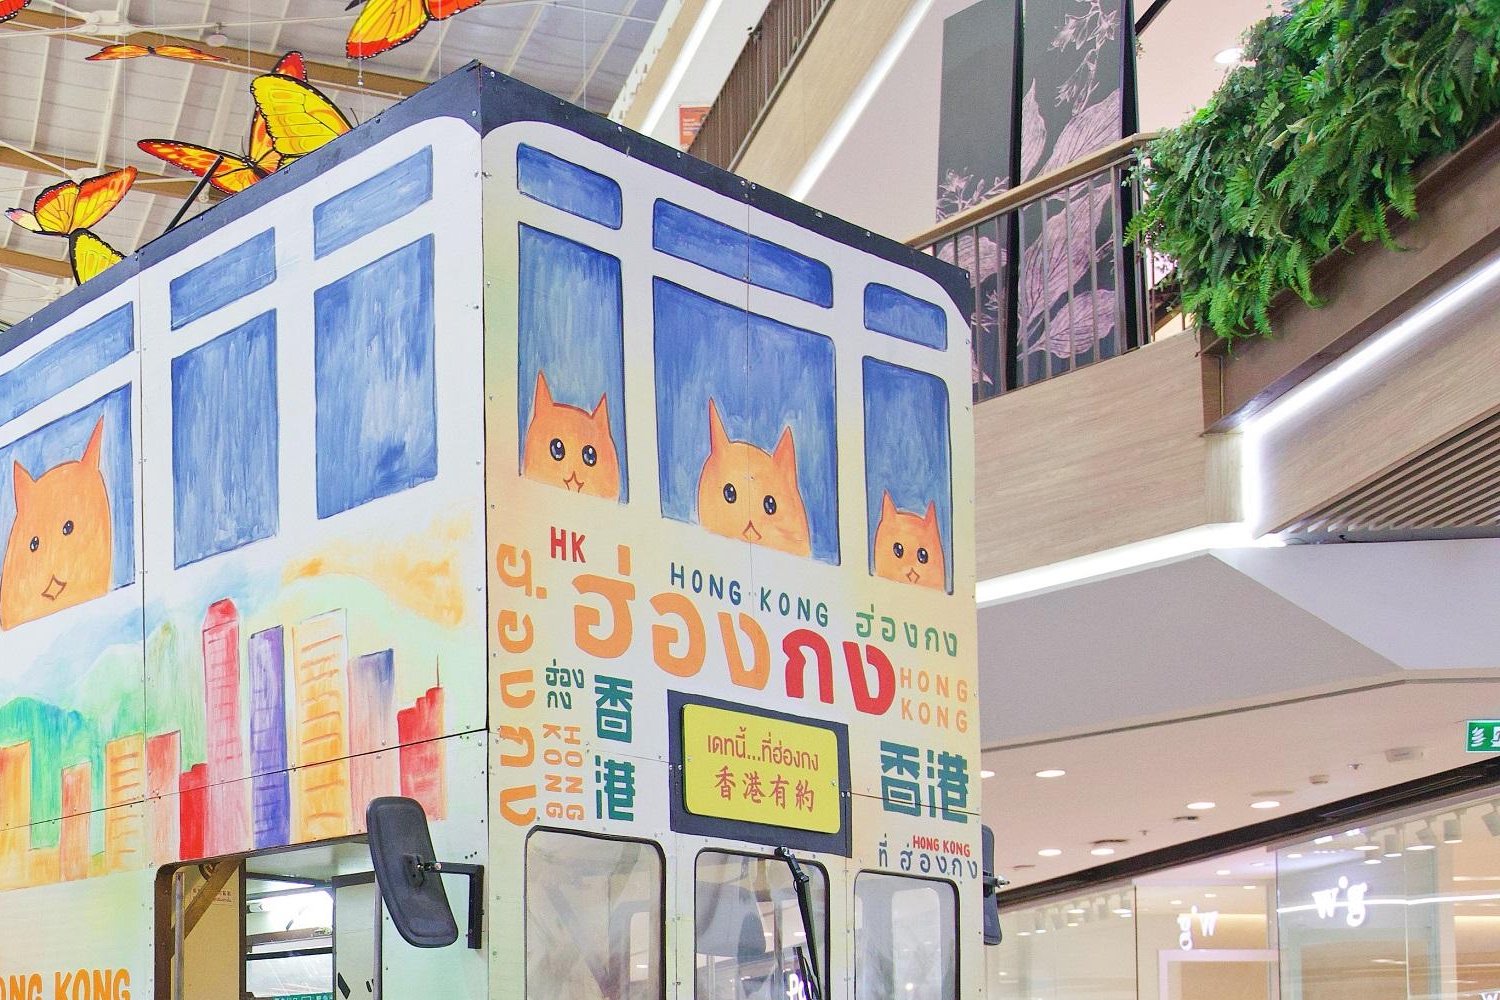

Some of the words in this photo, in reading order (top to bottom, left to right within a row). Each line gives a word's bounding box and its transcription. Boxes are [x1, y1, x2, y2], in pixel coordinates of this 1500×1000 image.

[550, 526, 586, 563] HK
[670, 562, 741, 606] HONG
[760, 586, 829, 627] KONG
[855, 603, 958, 658] ฮ่องกง
[546, 658, 585, 689] ฮ่อง
[900, 666, 968, 705] HONG
[547, 690, 572, 710] กง
[901, 696, 968, 734] KONG
[542, 722, 564, 820] KONG
[594, 673, 636, 822] 香港
[563, 724, 585, 821] HONG
[714, 765, 815, 814] 香港有約
[880, 740, 969, 824] 香港
[913, 834, 939, 851] HONG
[943, 839, 971, 858] KONG
